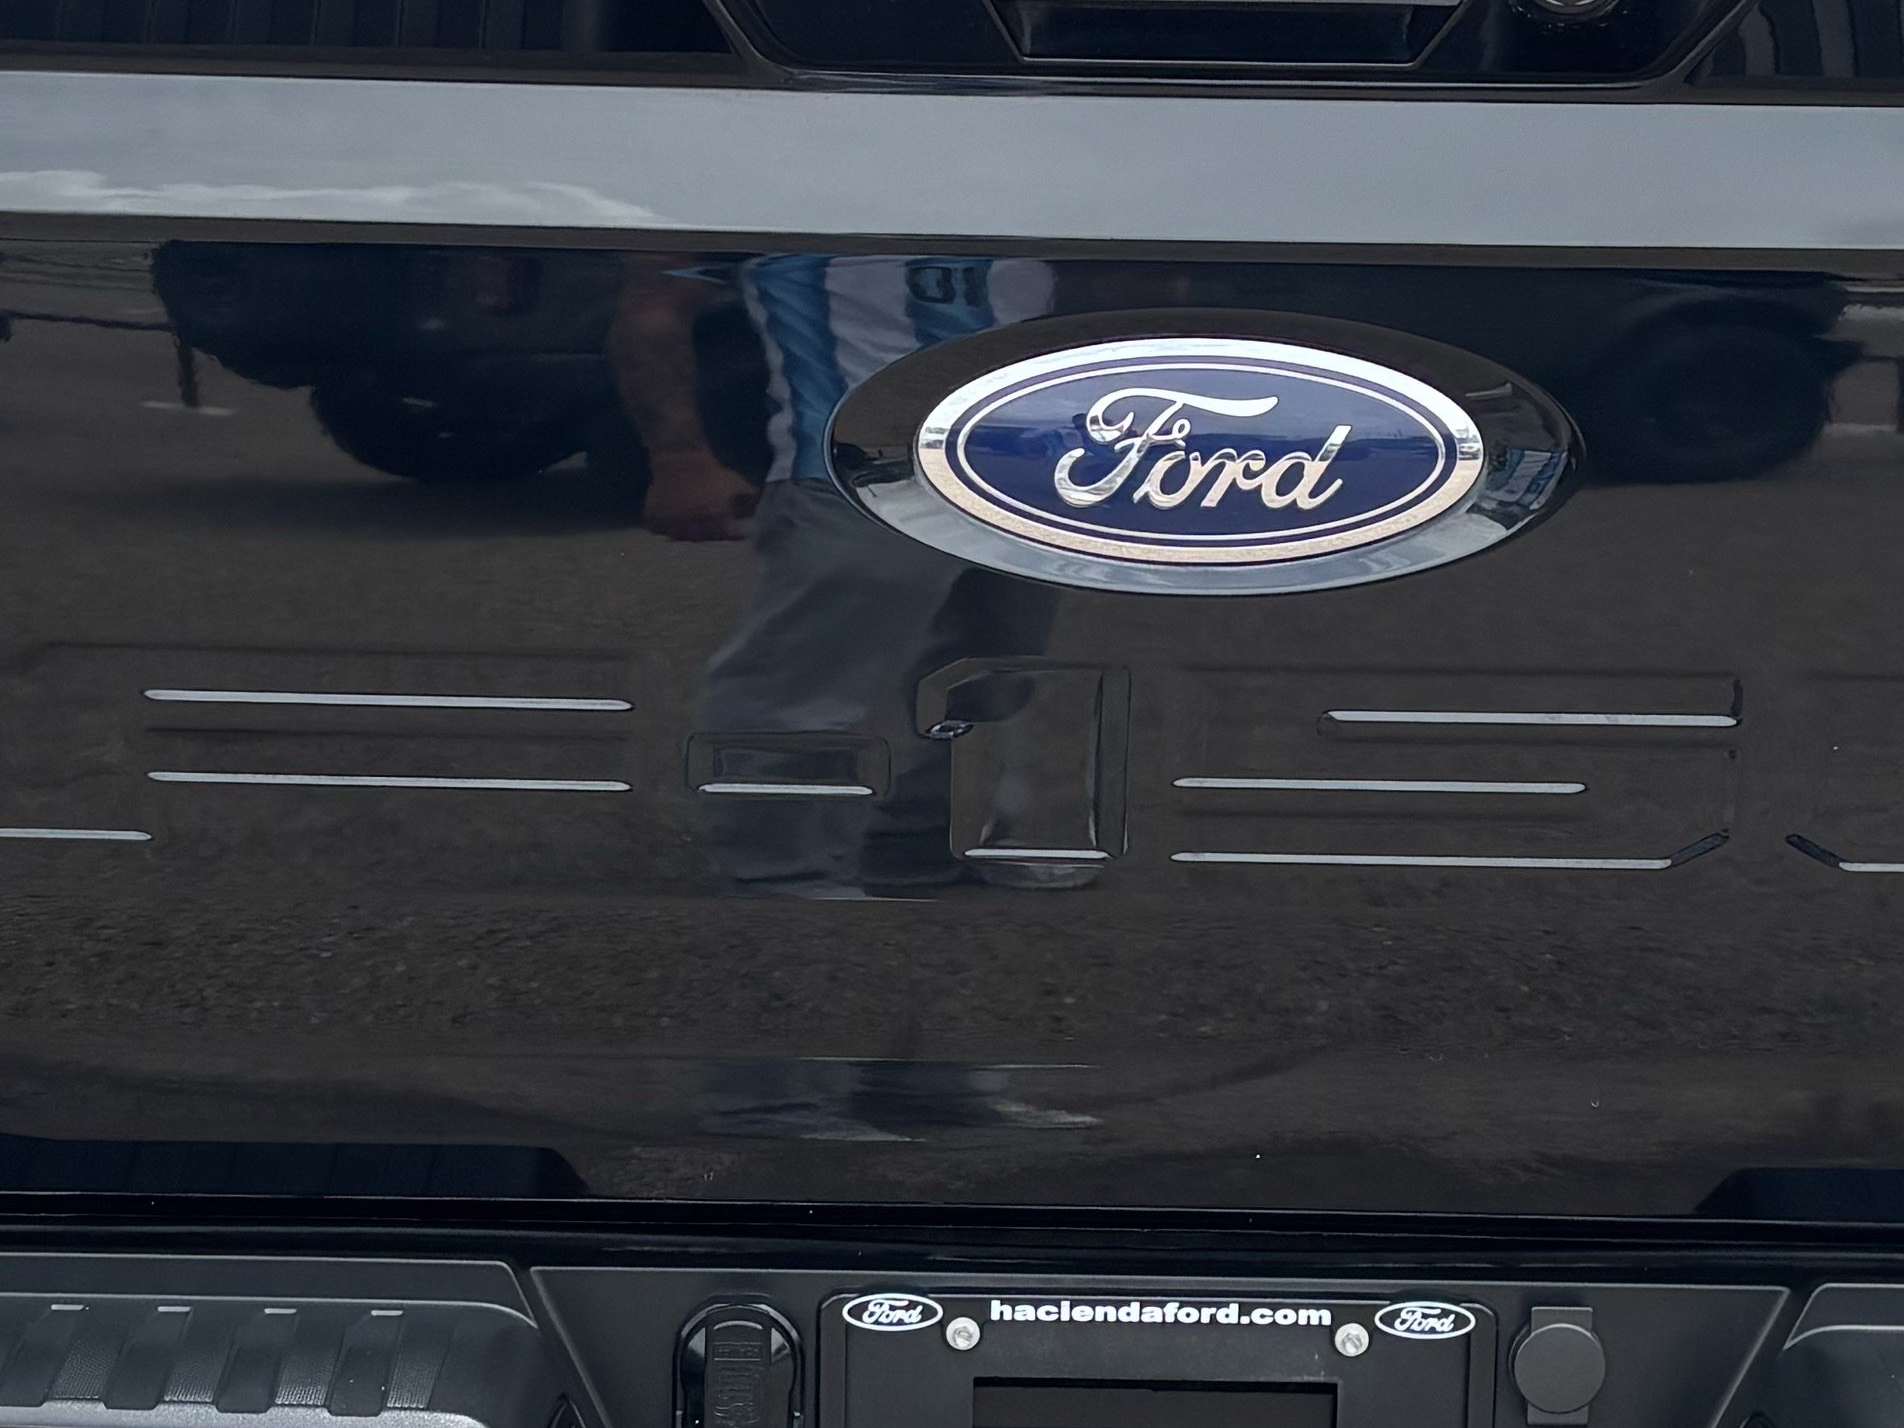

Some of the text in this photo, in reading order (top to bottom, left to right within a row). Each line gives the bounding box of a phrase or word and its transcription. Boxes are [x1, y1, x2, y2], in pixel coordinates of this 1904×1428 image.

[1053, 387, 1352, 510] Ford
[861, 1298, 923, 1324] Ford
[989, 1299, 1332, 1326] haciendaford.com
[1393, 1306, 1456, 1332] Ford
